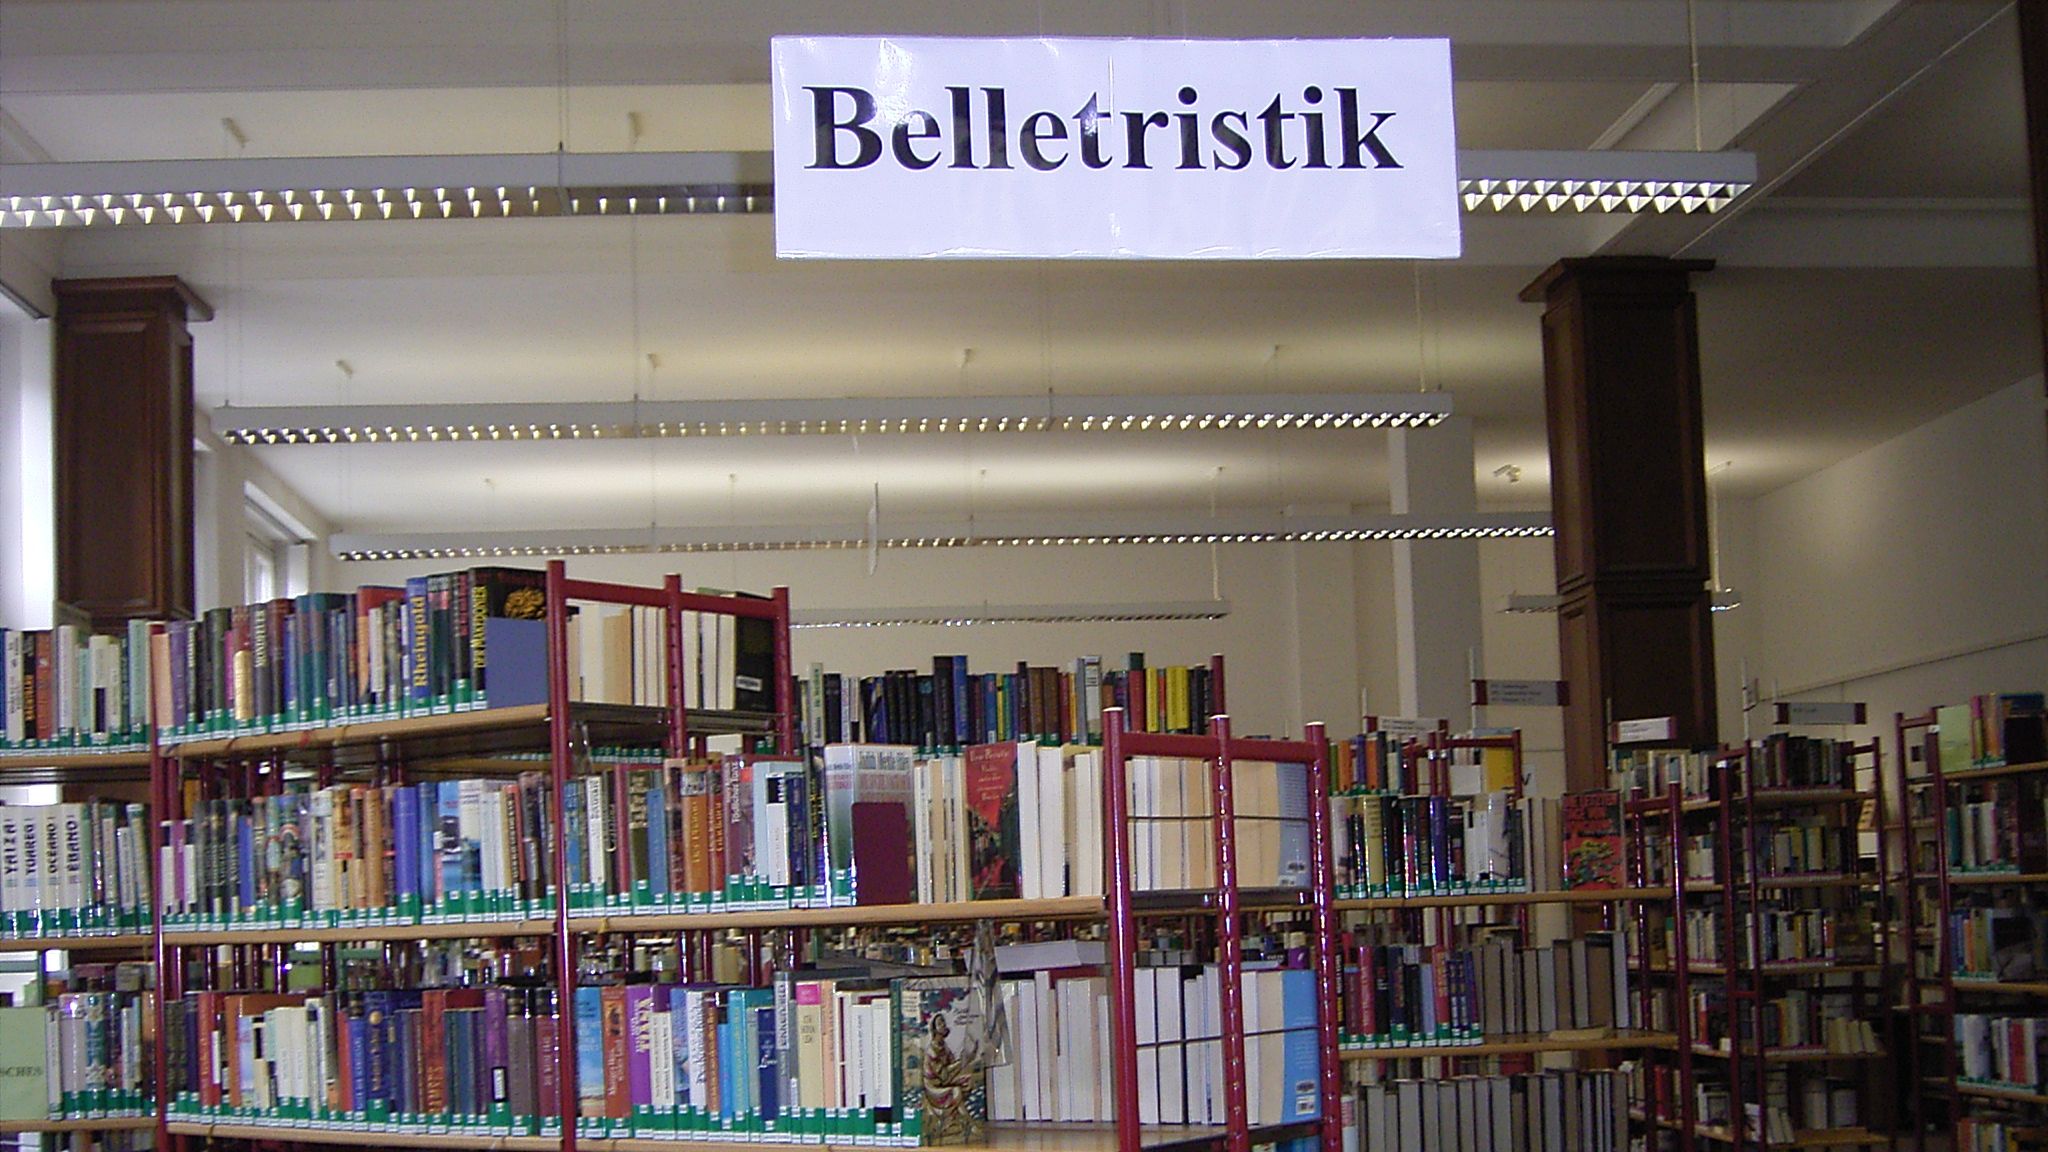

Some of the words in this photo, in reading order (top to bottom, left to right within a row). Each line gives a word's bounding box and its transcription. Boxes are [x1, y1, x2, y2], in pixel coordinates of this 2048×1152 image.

[802, 86, 1404, 171] Belletristik
[411, 597, 428, 687] Rheingold
[473, 648, 485, 668] DER
[3, 824, 19, 875] YAIZA
[23, 824, 37, 875] TUAREG
